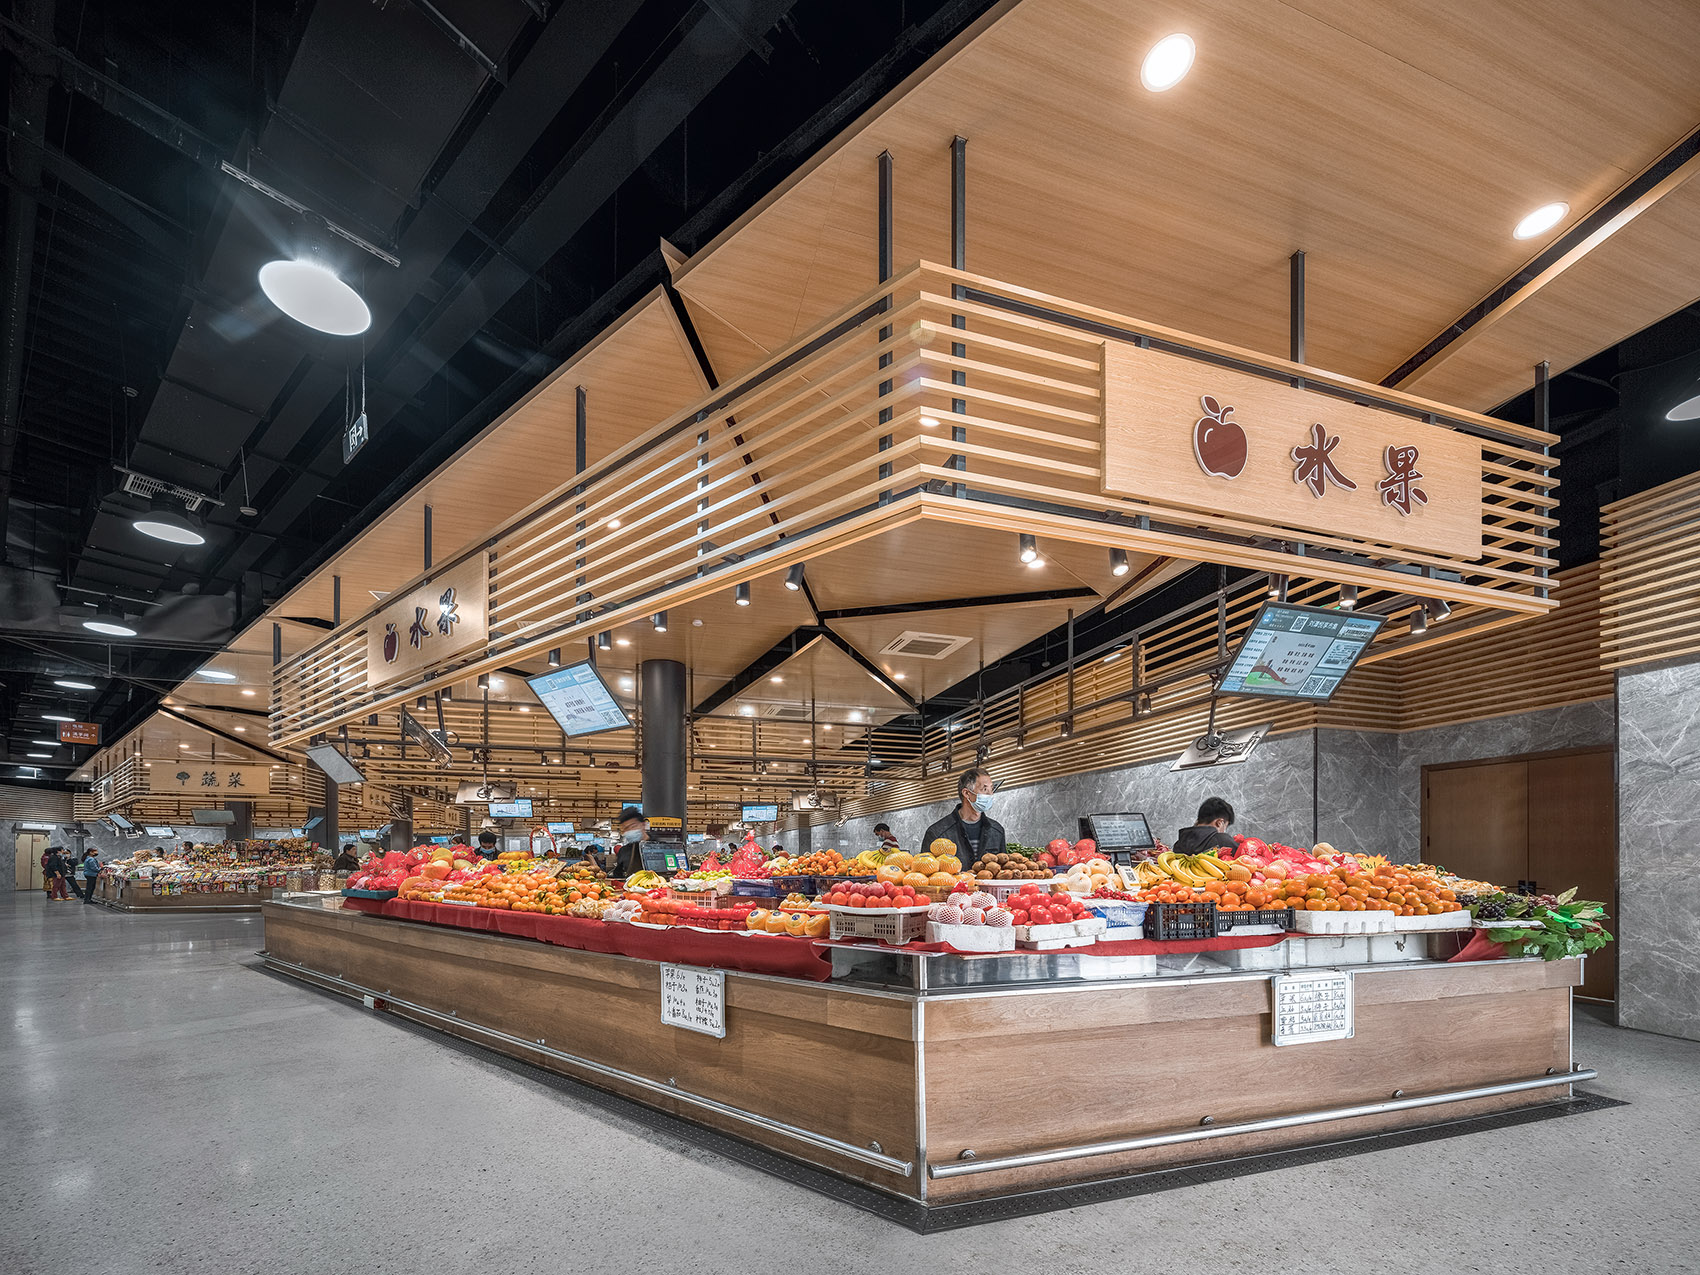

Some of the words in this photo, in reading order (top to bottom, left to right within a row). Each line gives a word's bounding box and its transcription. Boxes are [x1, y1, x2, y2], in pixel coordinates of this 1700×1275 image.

[1290, 423, 1428, 516] 水果
[409, 587, 458, 649] 水果
[201, 771, 245, 788] 蔬菜
